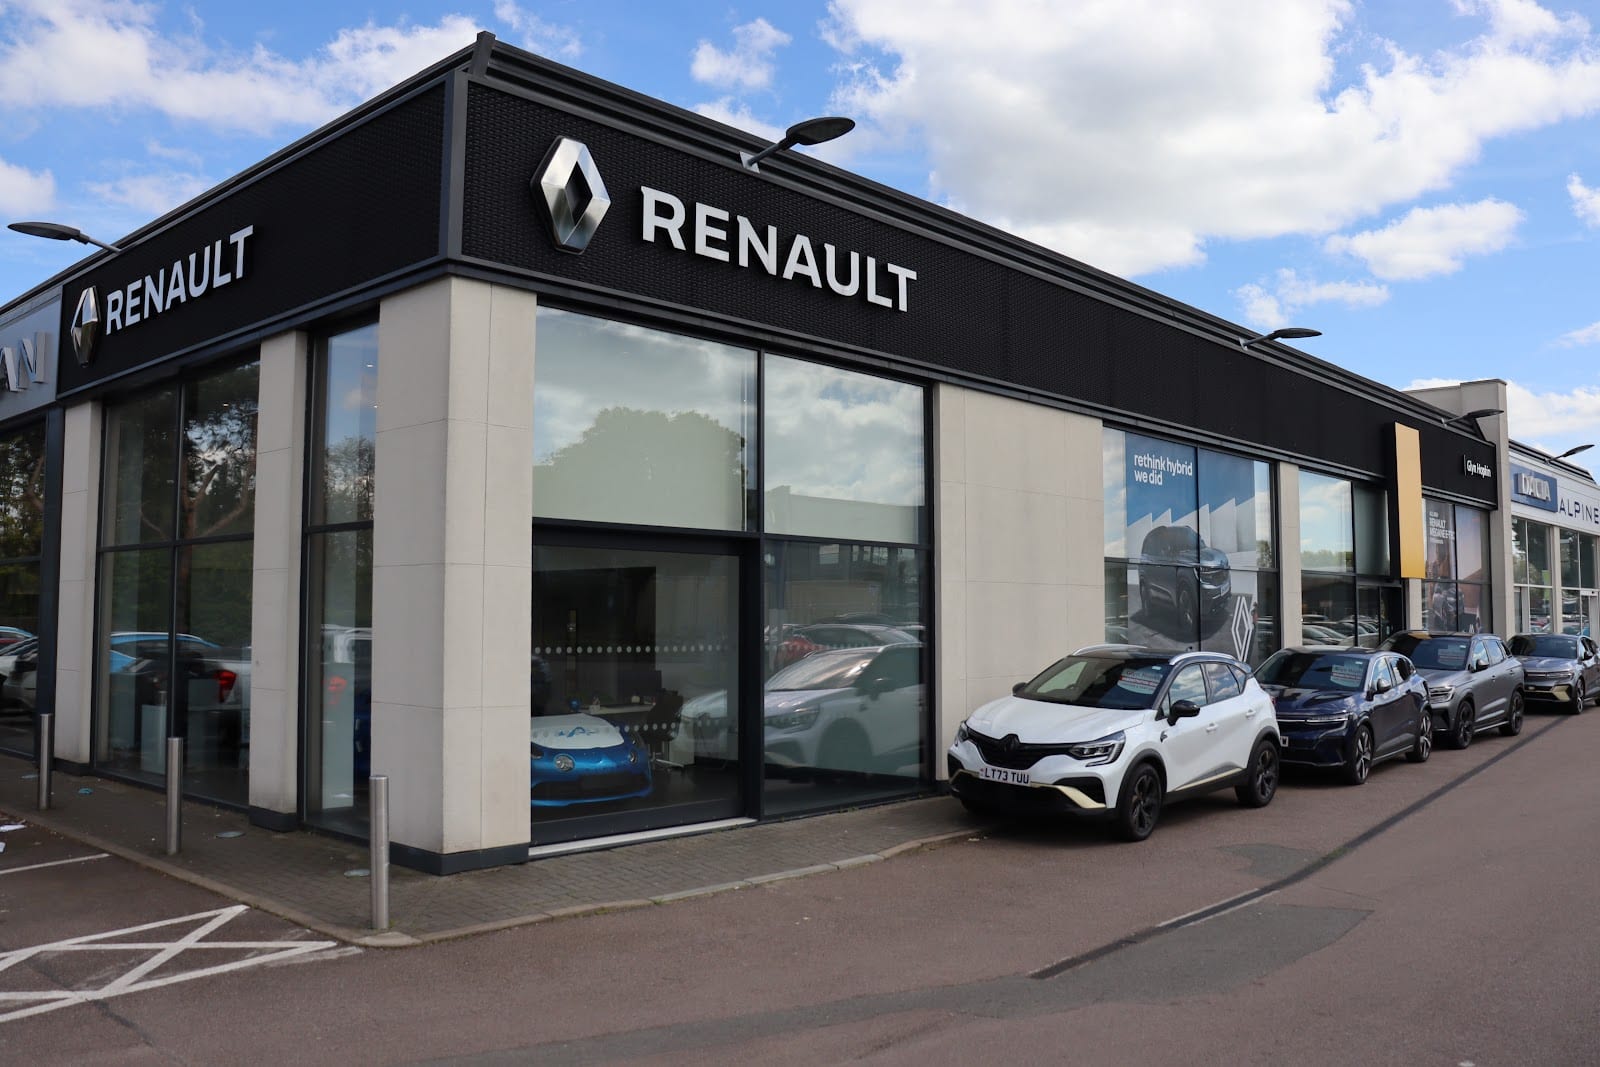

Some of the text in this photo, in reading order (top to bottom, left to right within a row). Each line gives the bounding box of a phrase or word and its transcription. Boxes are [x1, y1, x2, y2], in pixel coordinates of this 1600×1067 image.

[640, 185, 918, 312] RENAULT
[105, 225, 254, 336] RENAULT
[1134, 453, 1193, 476] rethink hybrid
[1134, 470, 1163, 486] we did
[1559, 498, 1599, 524] ALPINE
[984, 767, 1030, 784] LT73 TUU
